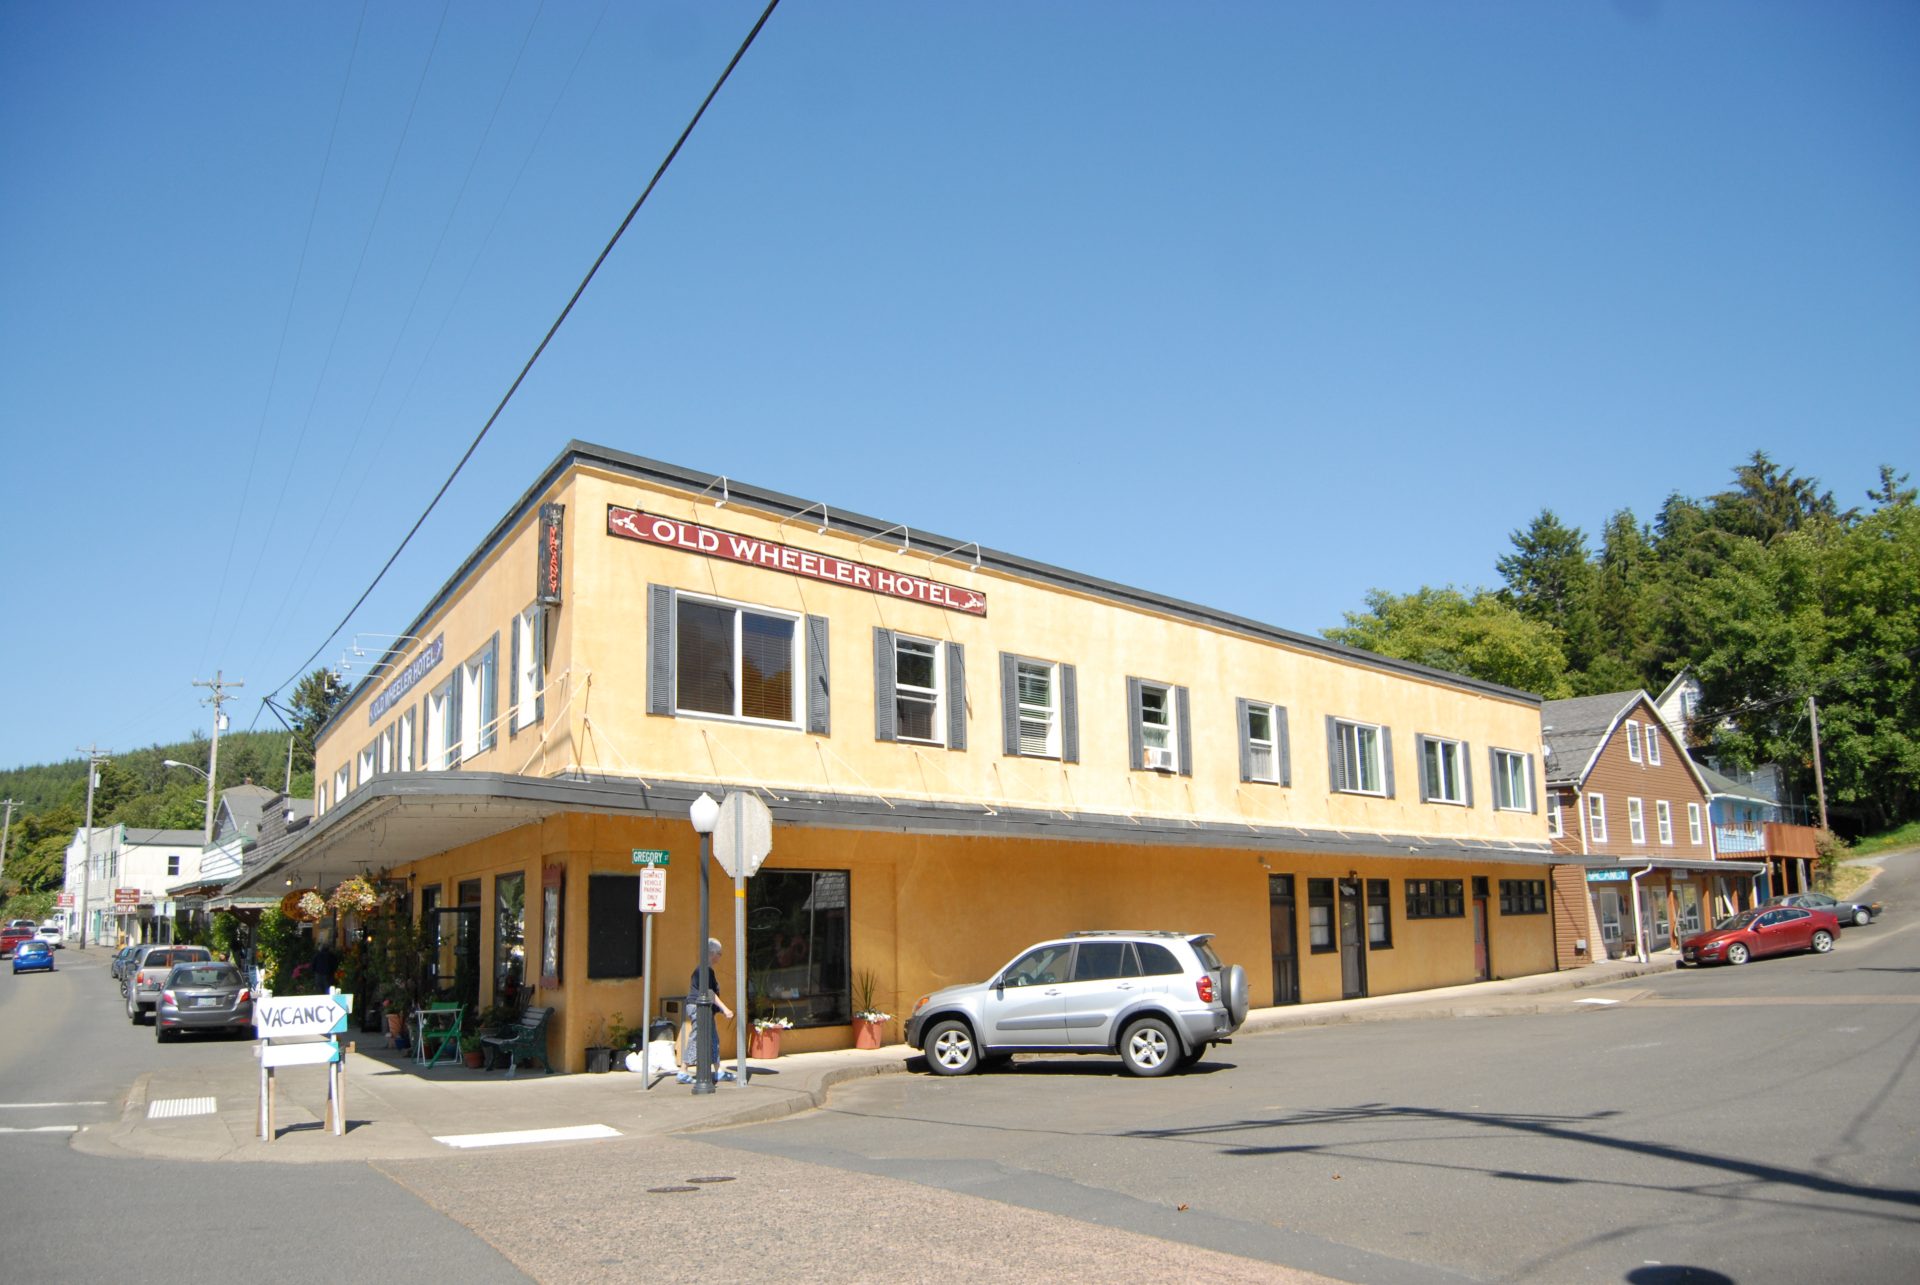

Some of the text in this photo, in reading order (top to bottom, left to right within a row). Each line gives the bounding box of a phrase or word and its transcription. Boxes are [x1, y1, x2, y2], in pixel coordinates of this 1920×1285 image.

[652, 520, 960, 606] OLD WHEELER HOTEL
[373, 647, 435, 718] OLD WHEELER HOTEL
[633, 851, 663, 863] GREGORY
[1587, 870, 1628, 880] VACANCY
[260, 1005, 336, 1027] VACANCY
